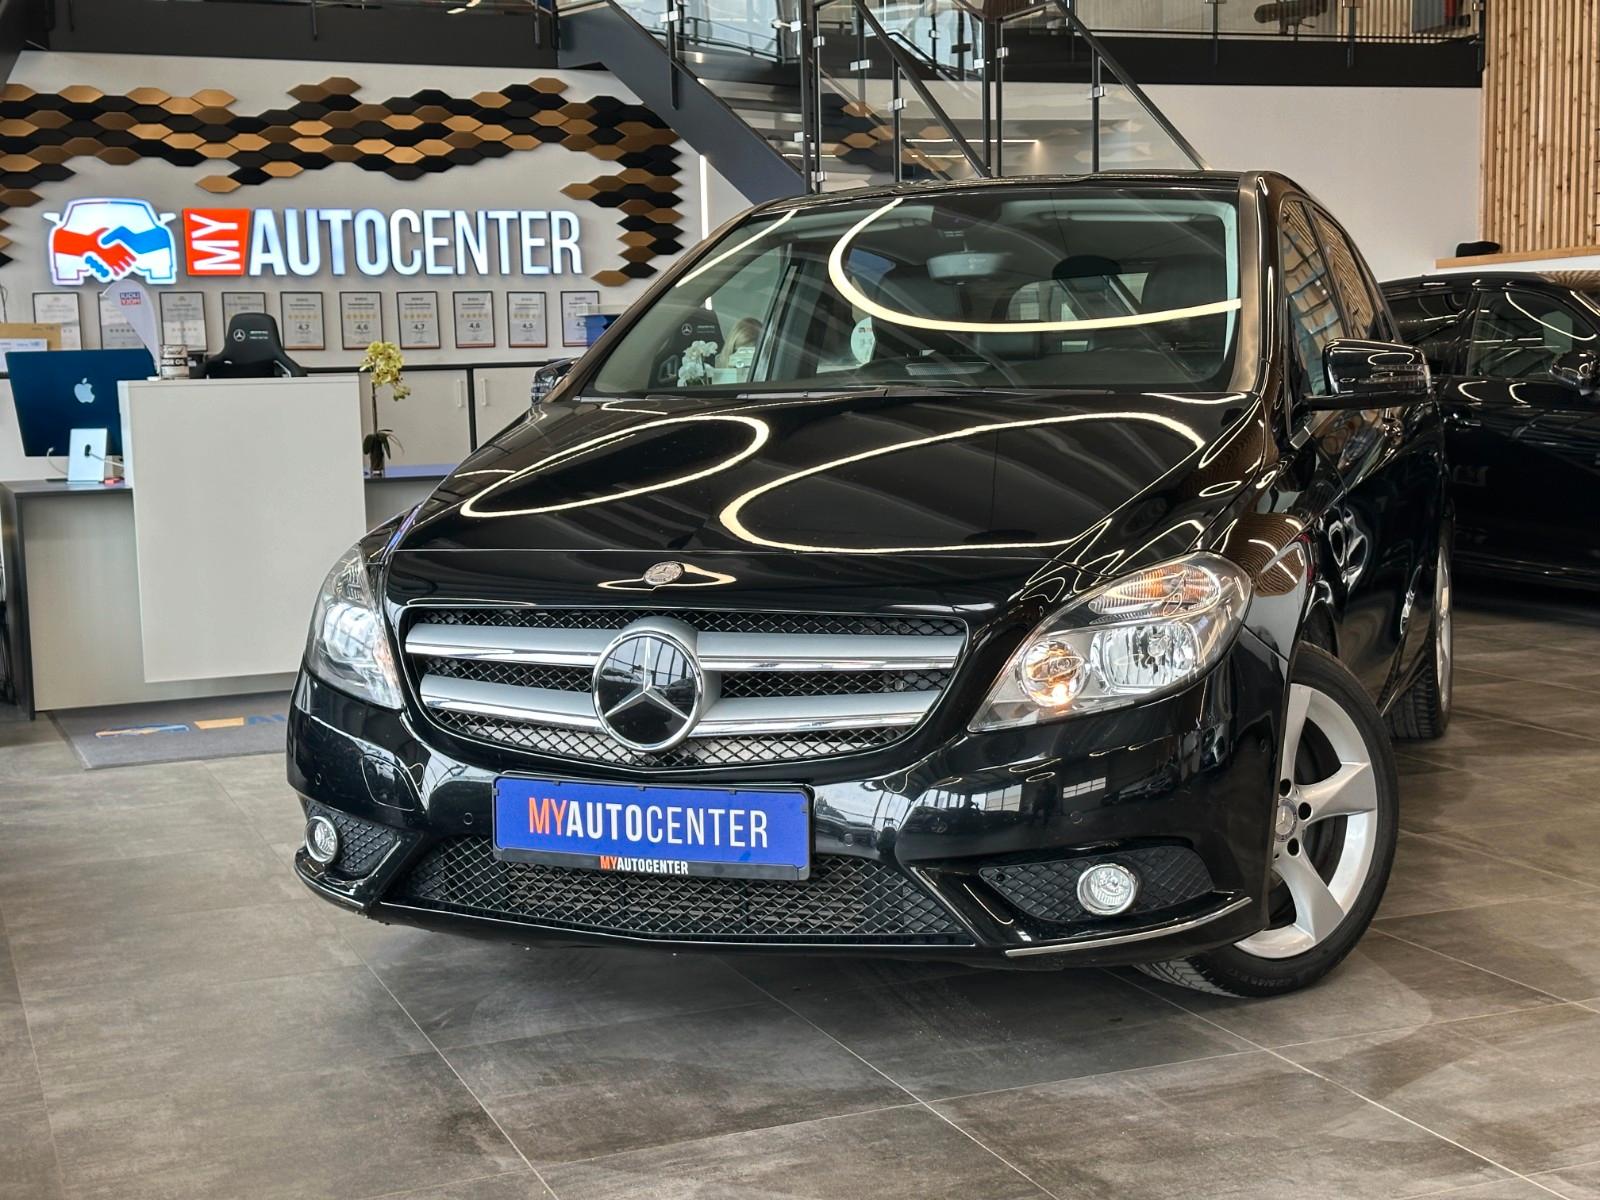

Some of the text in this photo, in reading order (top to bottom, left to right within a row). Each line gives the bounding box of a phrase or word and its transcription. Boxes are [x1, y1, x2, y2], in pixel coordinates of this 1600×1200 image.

[190, 207, 583, 276] MY AUTOCENTER
[528, 796, 769, 849] MYAUTOCENTER
[599, 855, 689, 876] MYAUTOCENTER
